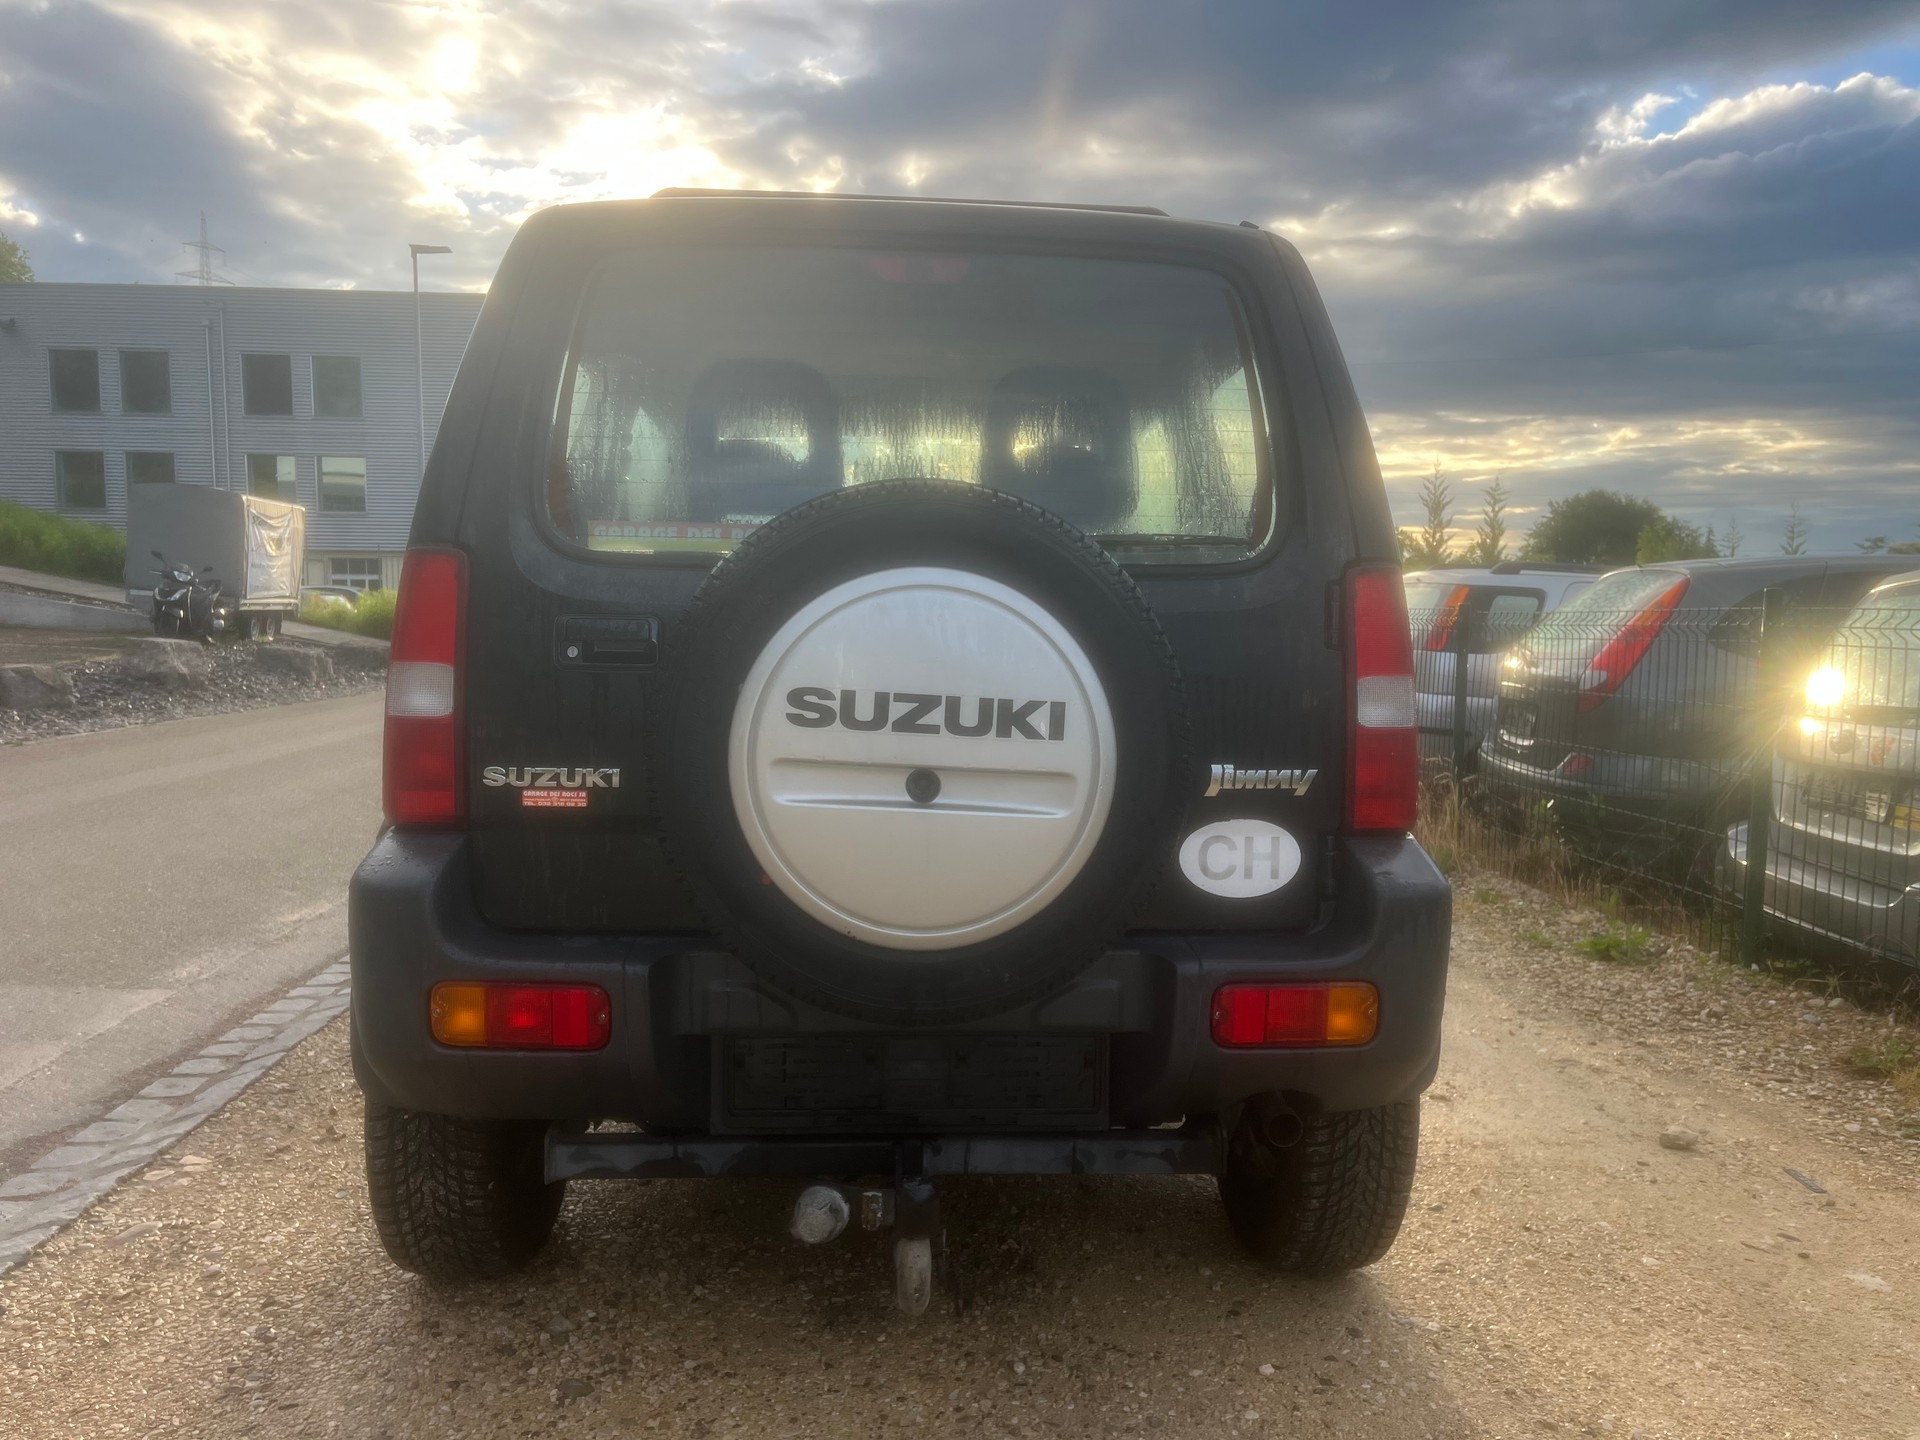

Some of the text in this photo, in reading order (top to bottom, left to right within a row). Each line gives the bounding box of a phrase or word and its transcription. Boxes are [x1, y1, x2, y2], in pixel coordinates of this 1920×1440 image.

[594, 526, 678, 542] GARAGE
[785, 686, 1066, 741] SUZUKI
[482, 766, 621, 788] SUZUKI
[1204, 764, 1318, 797] Jimny
[1198, 834, 1281, 881] CH
